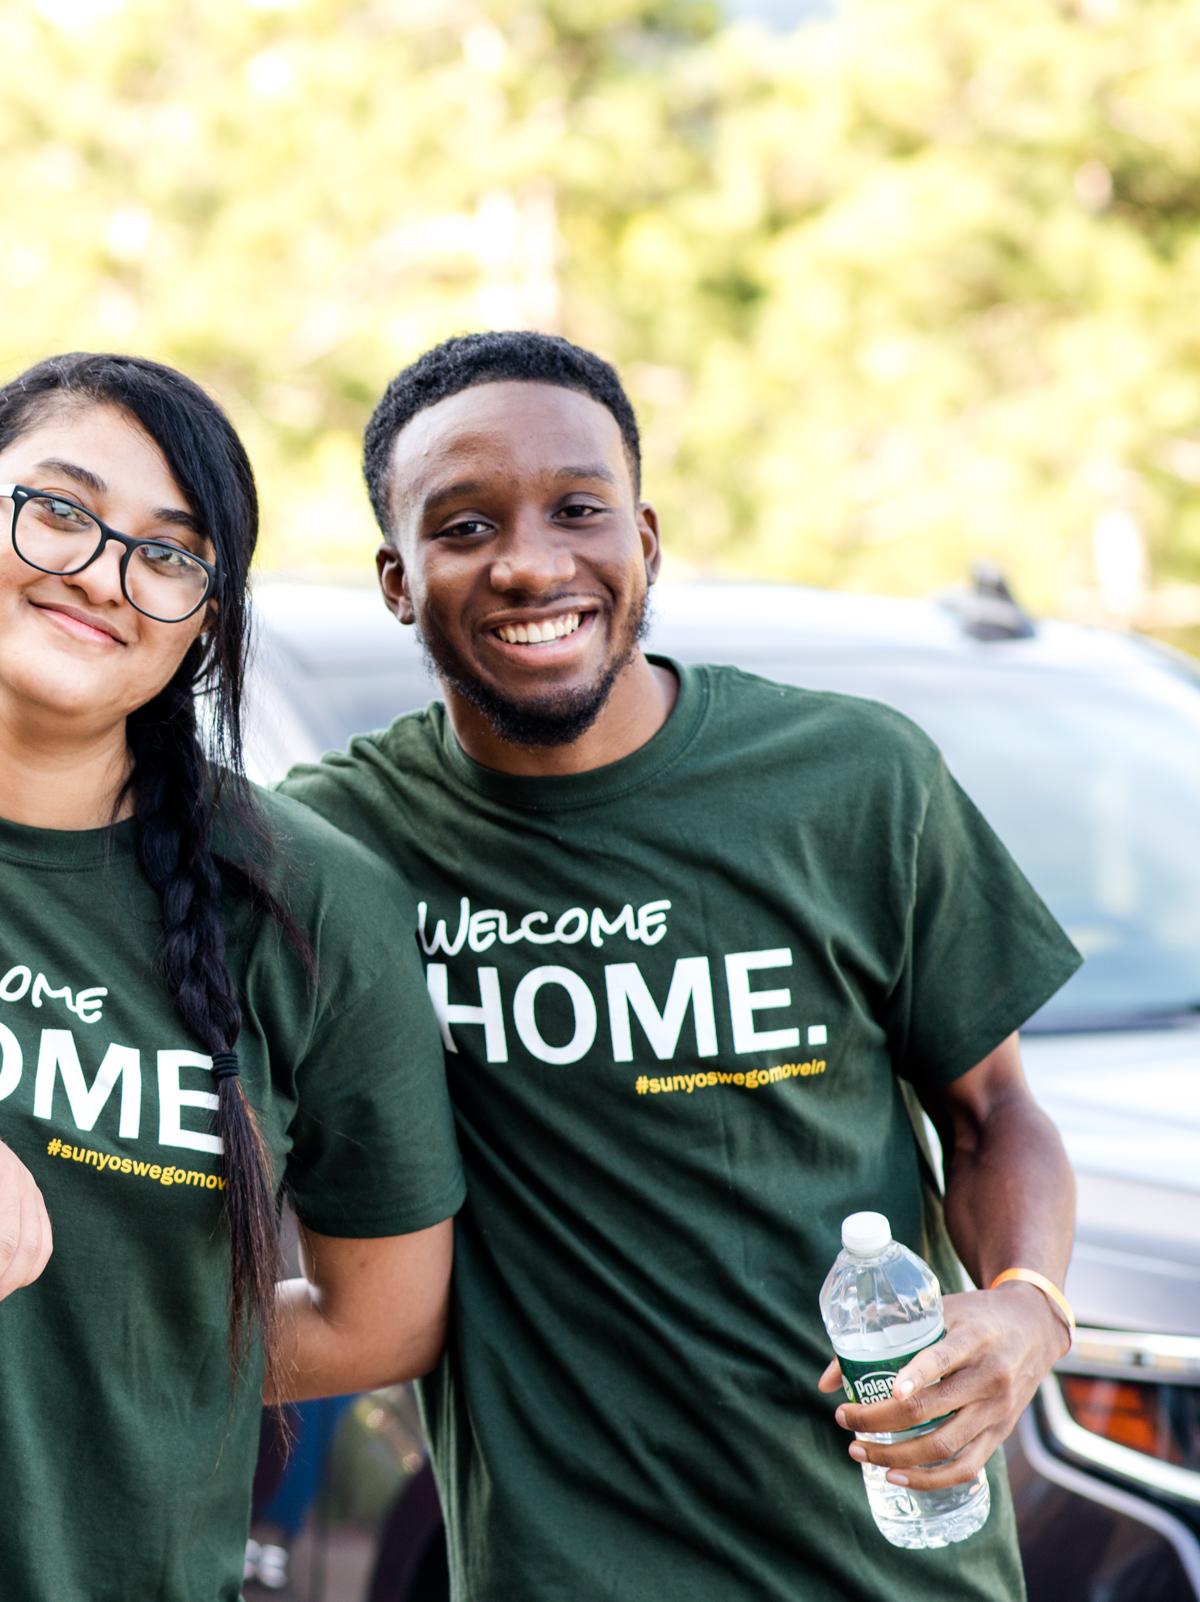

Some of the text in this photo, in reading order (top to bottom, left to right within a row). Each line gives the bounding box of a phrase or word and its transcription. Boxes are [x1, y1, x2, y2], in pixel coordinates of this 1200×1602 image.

[417, 896, 672, 957] WELCOME
[426, 947, 828, 1065] HOME.
[635, 1058, 827, 1095] #sunyoswegomovein
